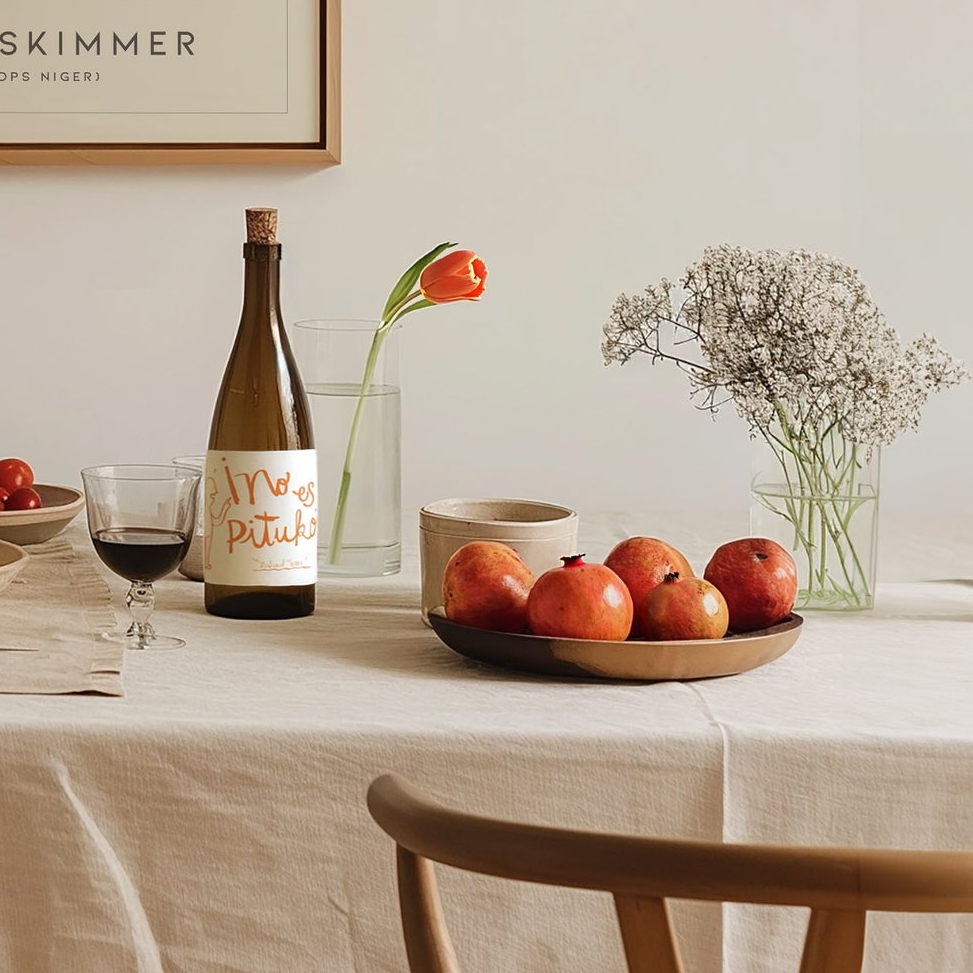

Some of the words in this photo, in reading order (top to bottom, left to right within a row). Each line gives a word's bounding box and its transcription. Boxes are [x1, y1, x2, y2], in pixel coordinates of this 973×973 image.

[0, 30, 195, 56] SKIMMER
[40, 71, 100, 82] NIGER)
[292, 482, 315, 507] es
